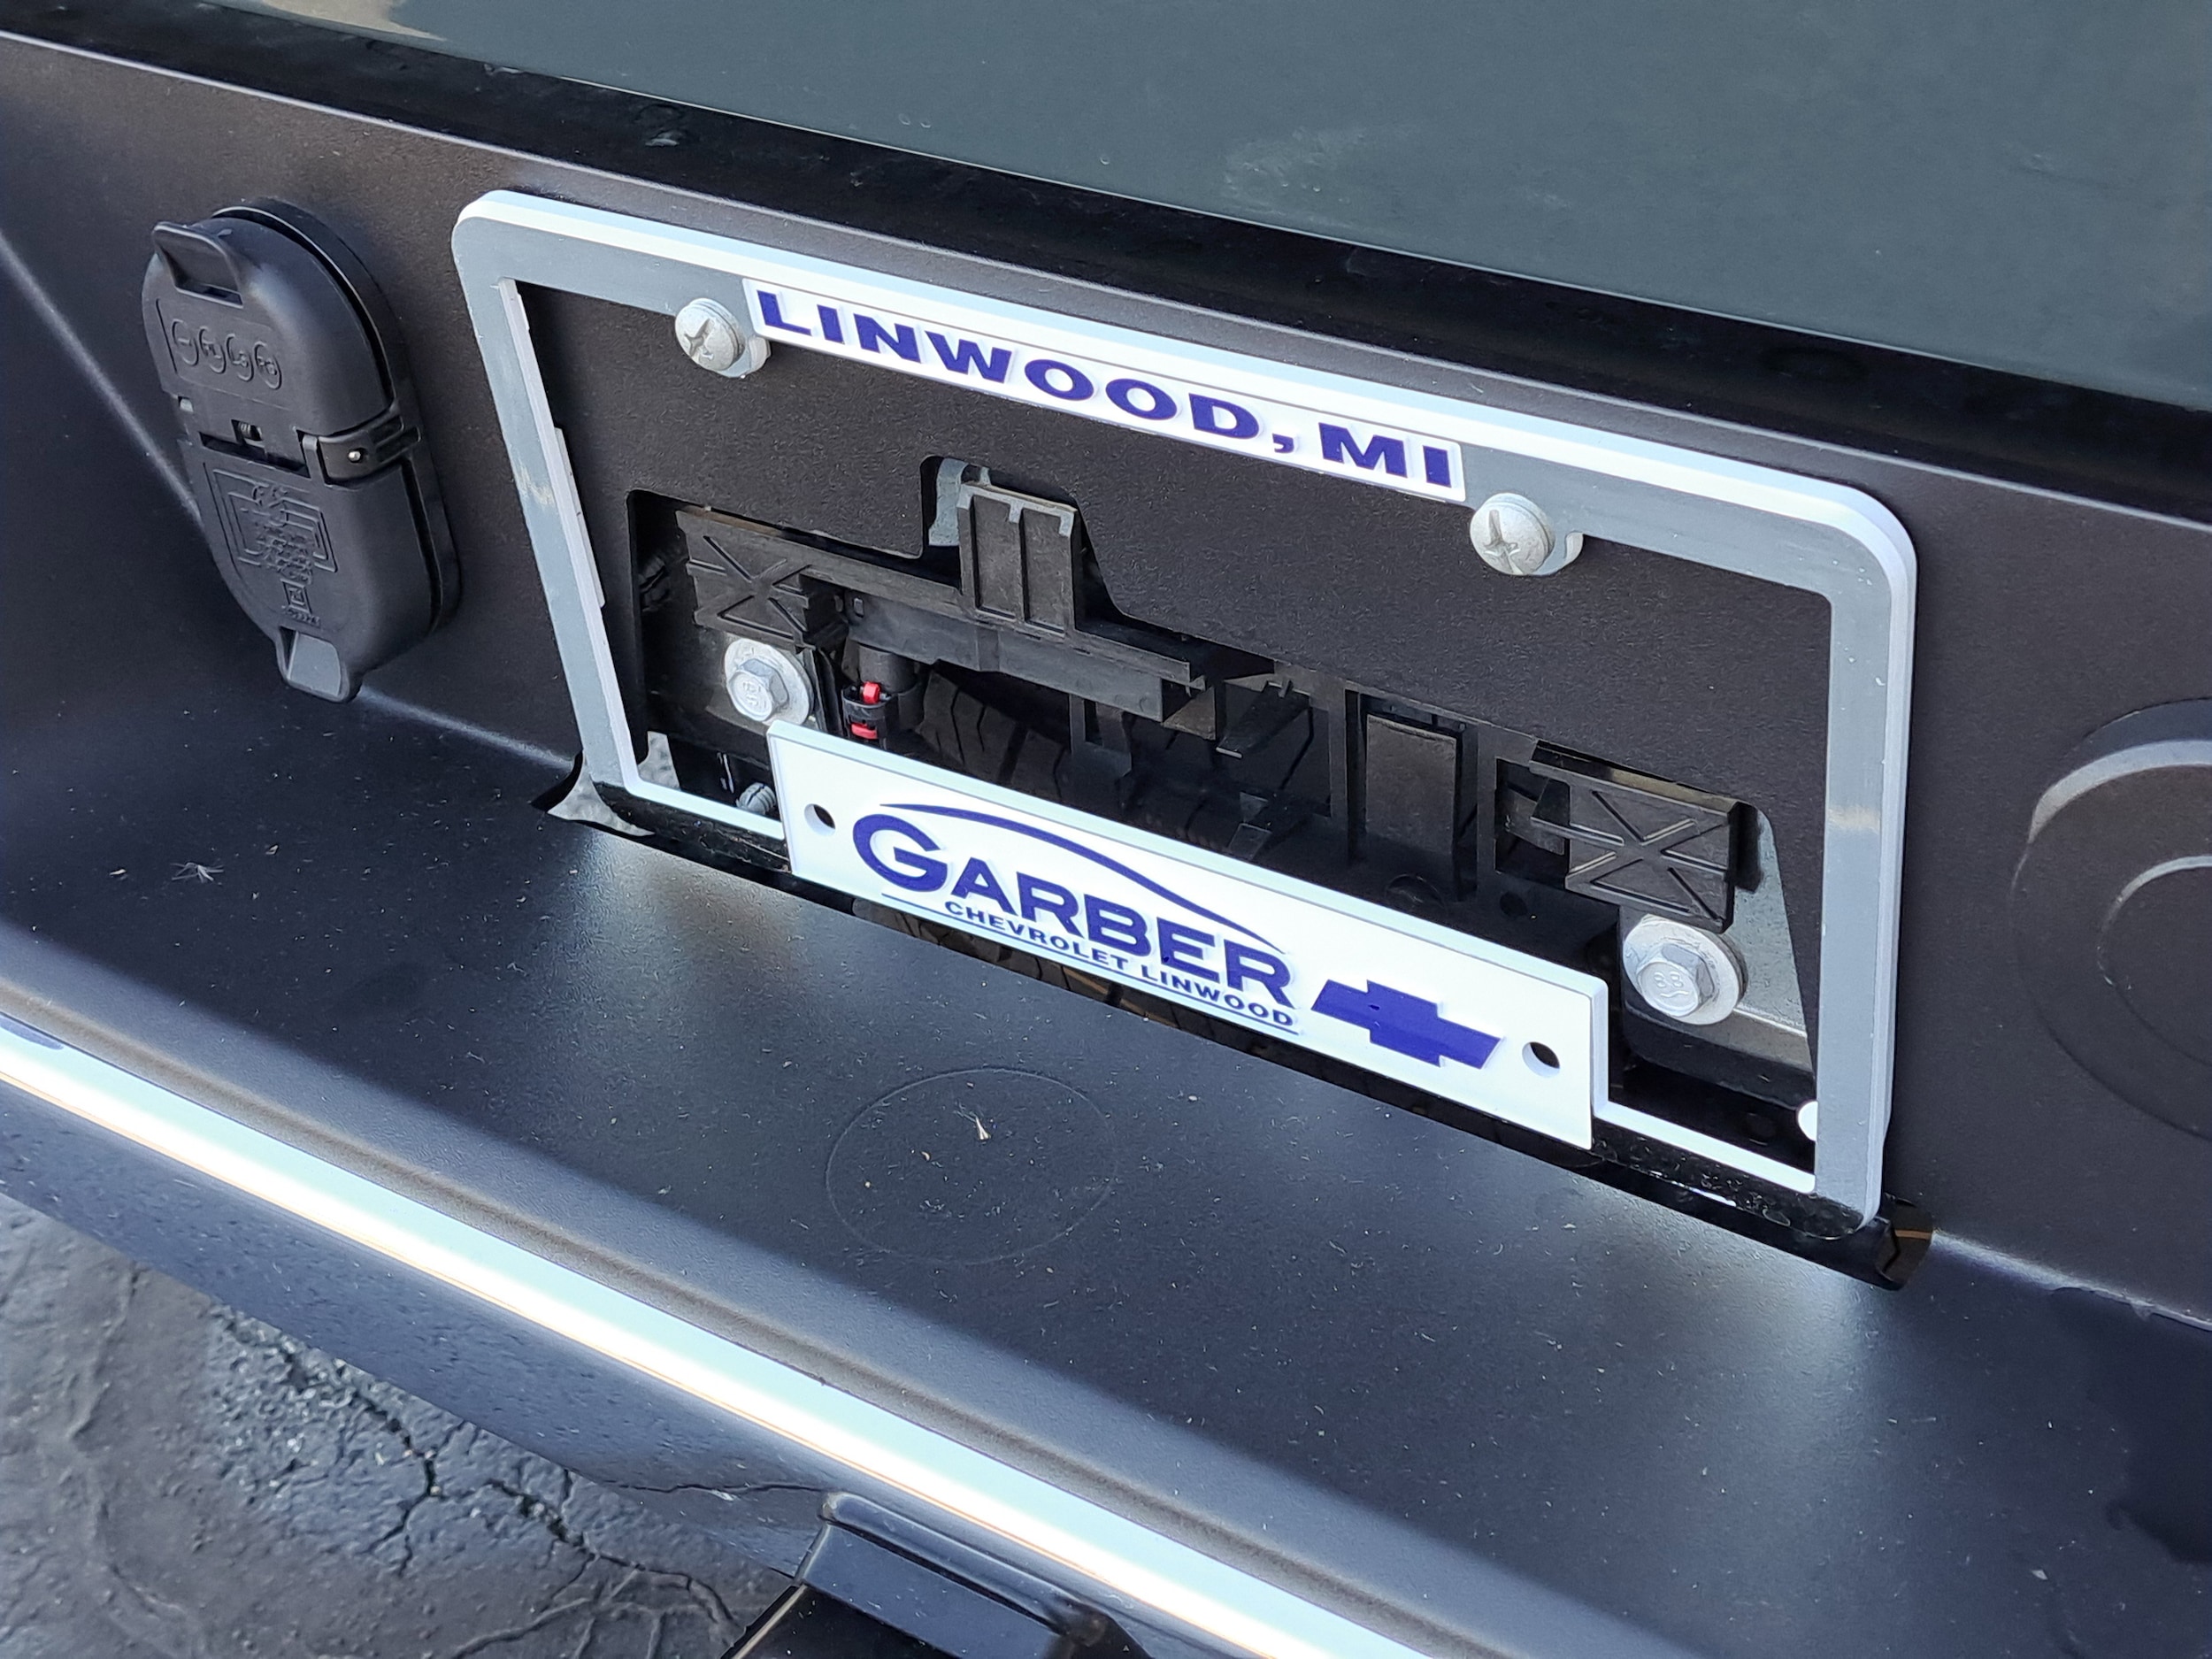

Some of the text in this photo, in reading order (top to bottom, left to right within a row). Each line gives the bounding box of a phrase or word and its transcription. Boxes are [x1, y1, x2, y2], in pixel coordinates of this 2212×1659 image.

[852, 813, 1294, 1010] GARBER
[944, 901, 1294, 1026] CHEVROLET LINWOOD
